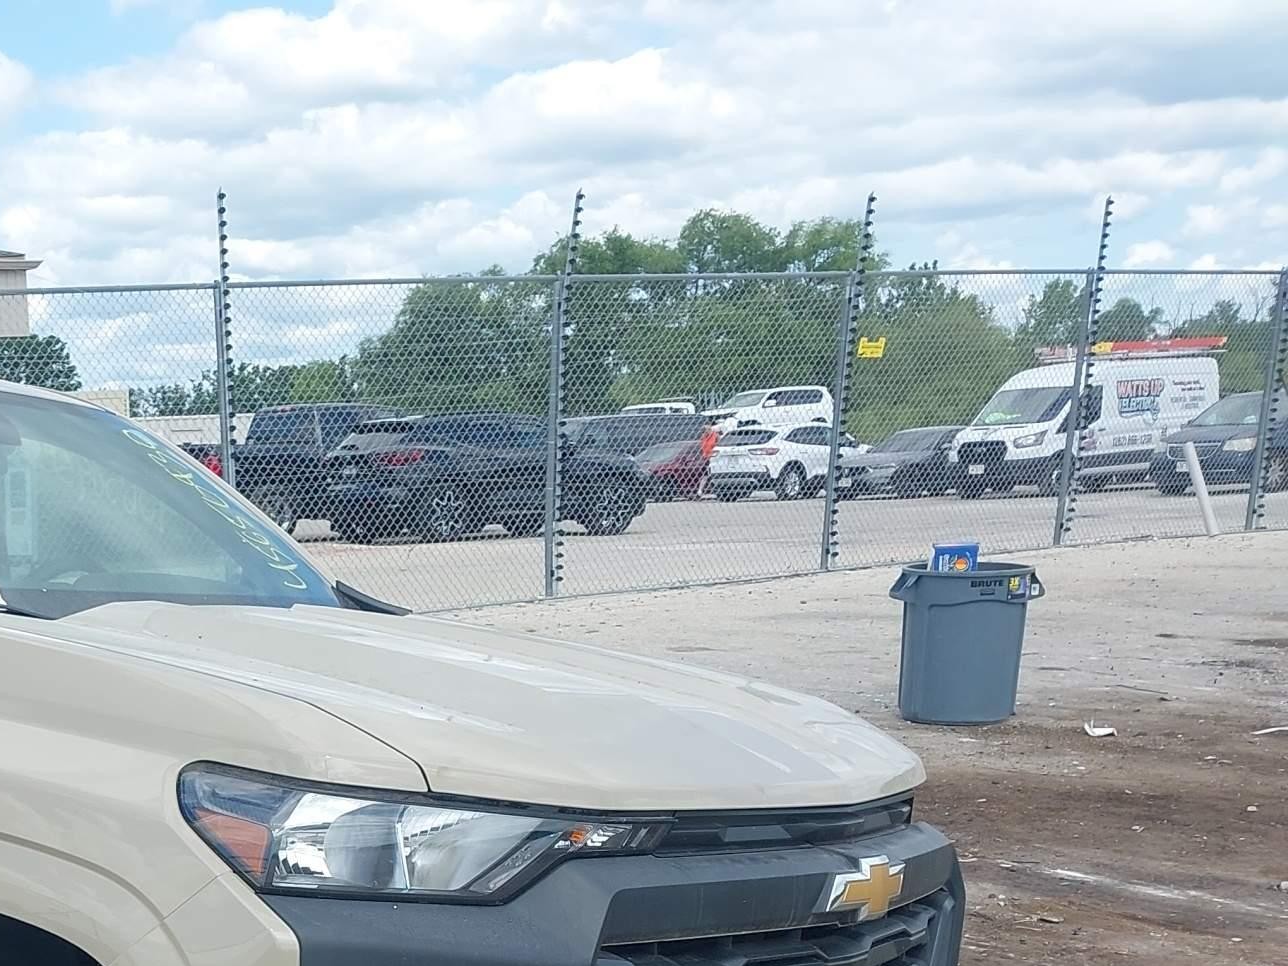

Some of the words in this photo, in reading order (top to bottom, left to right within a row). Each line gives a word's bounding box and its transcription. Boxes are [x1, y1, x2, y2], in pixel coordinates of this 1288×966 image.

[1118, 380, 1150, 399] WATTS
[1150, 379, 1164, 397] UP
[970, 580, 1004, 588] BRUTE
